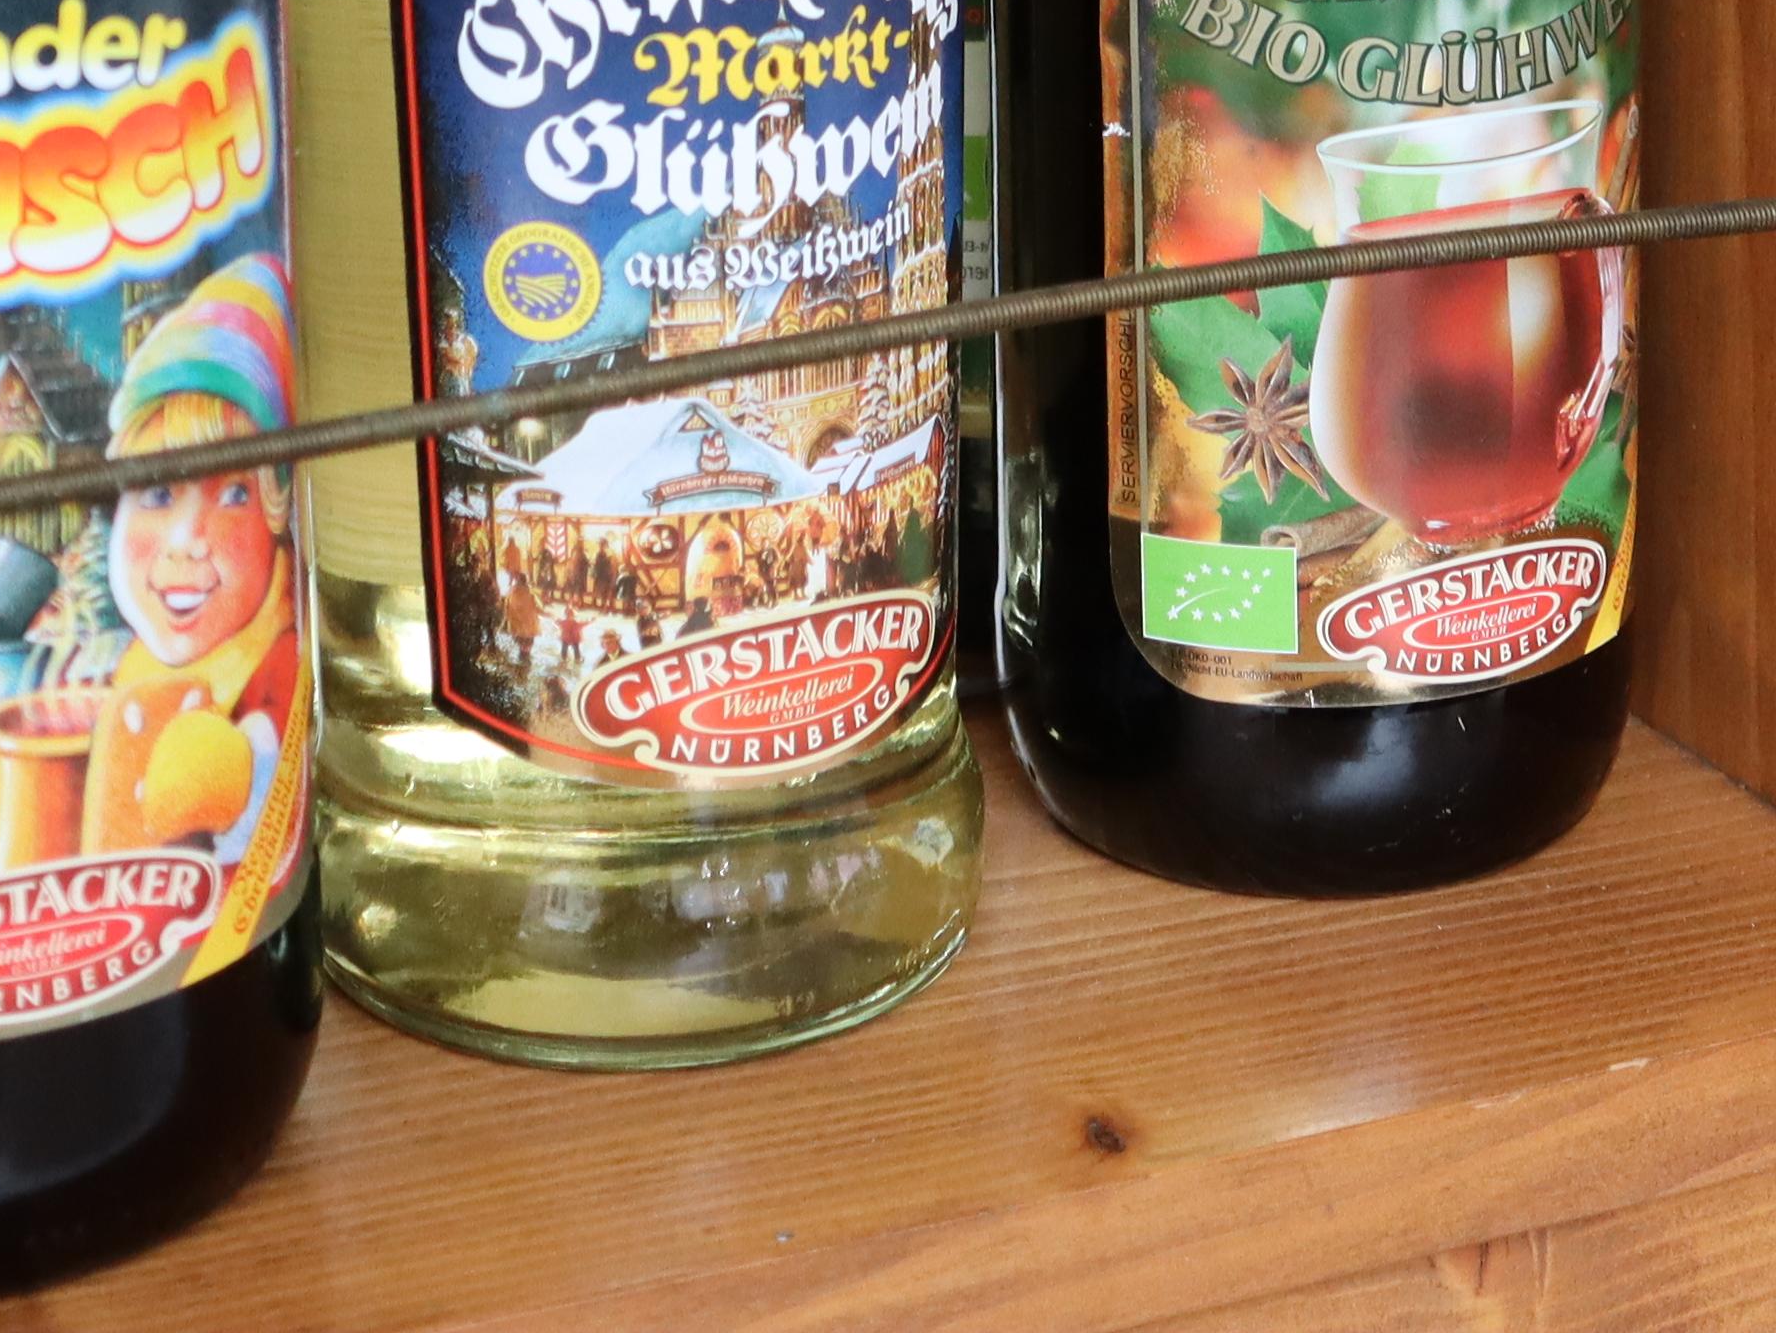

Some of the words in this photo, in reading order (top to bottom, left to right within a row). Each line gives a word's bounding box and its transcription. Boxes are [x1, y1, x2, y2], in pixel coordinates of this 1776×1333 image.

[634, 6, 911, 107] Markt-
[524, 60, 946, 237] Glühwein
[625, 245, 718, 292] aus
[723, 200, 912, 292] Weißwein
[1344, 551, 1595, 639] GERSTACKER
[1435, 597, 1538, 638] Weinkellerei
[605, 606, 924, 723] GERSTACKER
[1395, 613, 1568, 672] NÜRNBERG
[670, 687, 892, 764] NÜRNBERG
[721, 669, 854, 719] Weinkellerei
